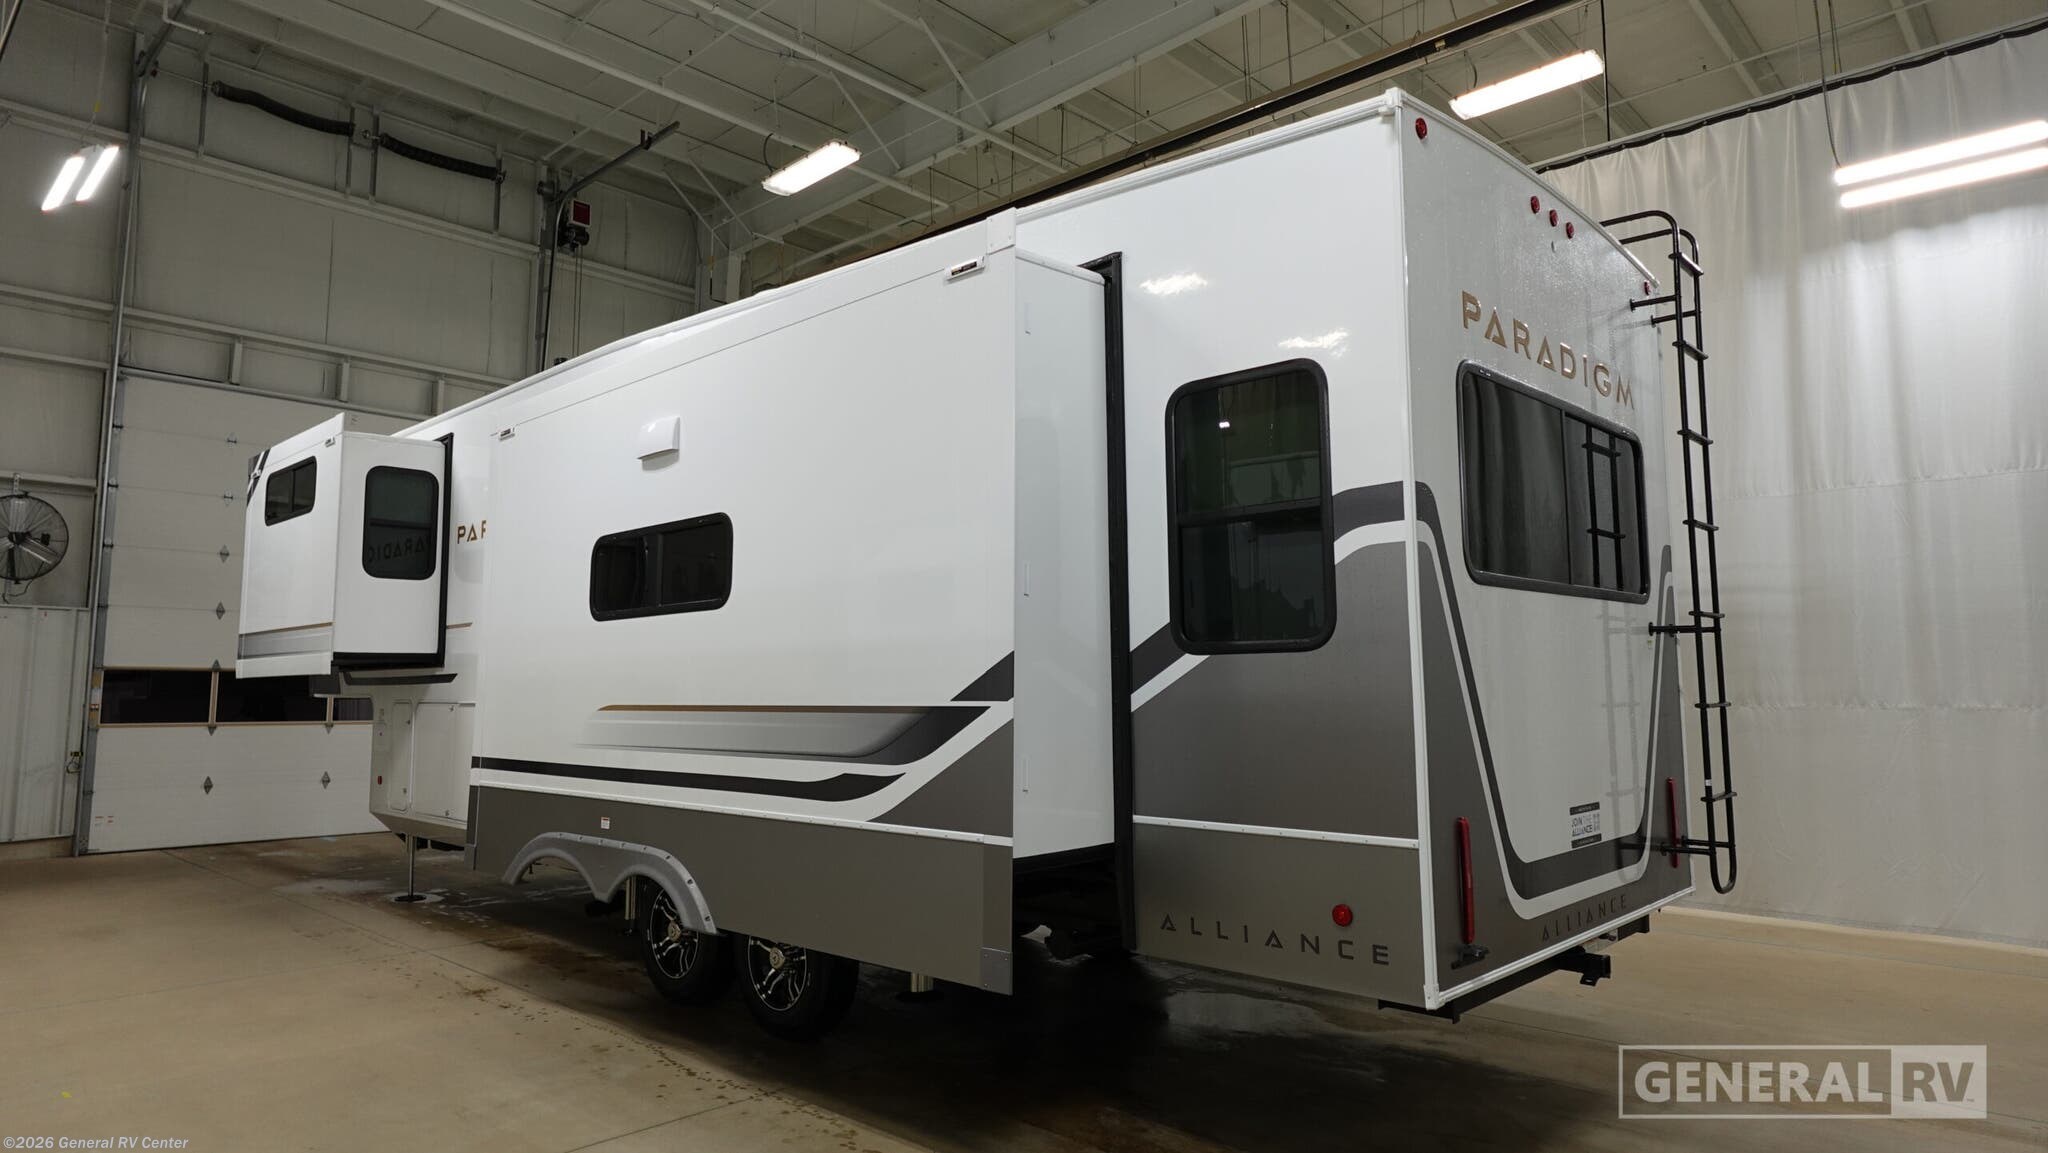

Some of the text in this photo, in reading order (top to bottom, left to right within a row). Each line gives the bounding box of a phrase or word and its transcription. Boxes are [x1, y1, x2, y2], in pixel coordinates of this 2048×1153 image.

[1461, 289, 1635, 410] PARADIGM
[1160, 913, 1390, 966] ALLIANCE
[1542, 894, 1627, 942] ALLIANCE
